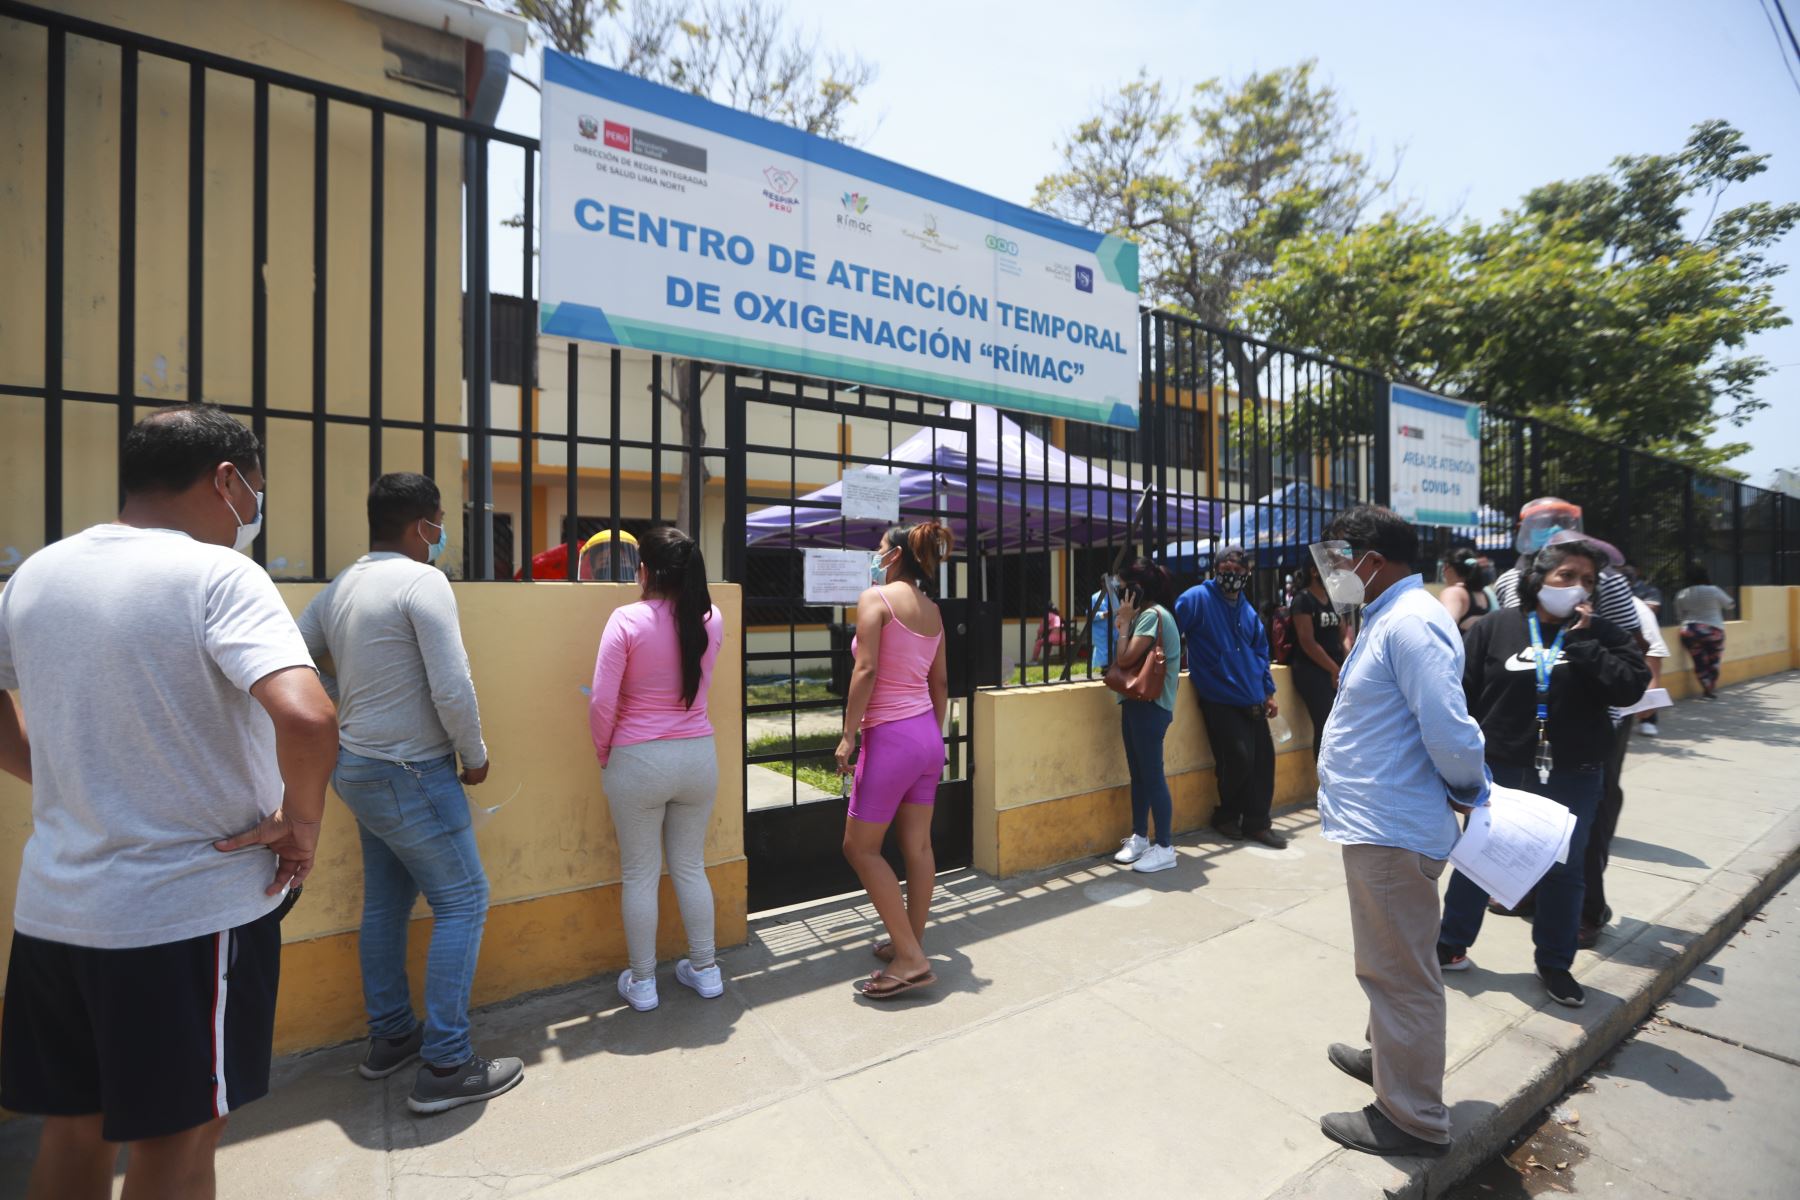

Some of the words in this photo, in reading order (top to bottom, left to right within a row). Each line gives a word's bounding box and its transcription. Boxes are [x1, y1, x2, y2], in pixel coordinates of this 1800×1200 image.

[573, 143, 619, 163] DIRECCIÓN
[621, 157, 631, 167] DE
[634, 158, 658, 174] REDES
[660, 167, 708, 187] INTEGRADAS
[596, 162, 607, 173] DE
[609, 165, 636, 180] SALUD
[637, 173, 659, 186] LIMA
[660, 179, 686, 193] NORTE
[762, 189, 800, 205] RESPIRA
[769, 203, 793, 214] PERÚ
[836, 214, 872, 233] Rímac
[574, 198, 755, 266] CENTRO
[768, 243, 816, 281] DE
[827, 258, 988, 322] ATENCIÓN
[996, 301, 1127, 355] TEMPORAL
[666, 275, 721, 315] DE
[734, 291, 971, 363] OXIGENACIÓN
[980, 342, 1084, 384] “RÍMAC”
[1427, 456, 1438, 471] DE
[1440, 457, 1476, 475] ATENCIÓN
[1422, 480, 1461, 496] COVID-19
